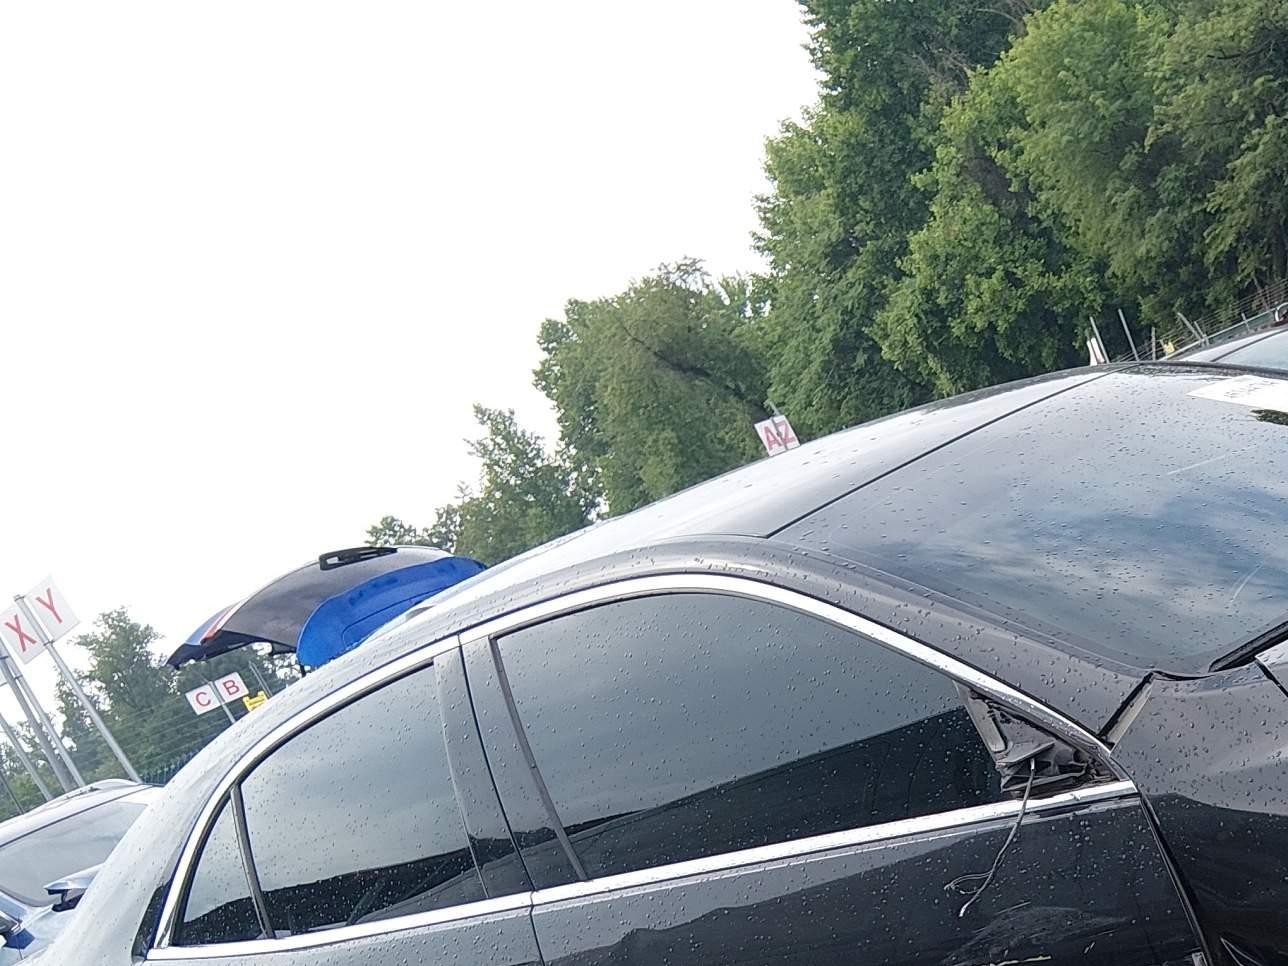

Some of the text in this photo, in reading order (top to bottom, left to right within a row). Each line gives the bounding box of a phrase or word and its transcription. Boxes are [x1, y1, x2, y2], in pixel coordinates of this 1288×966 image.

[5, 587, 63, 652] X Y
[195, 679, 240, 707] C B
